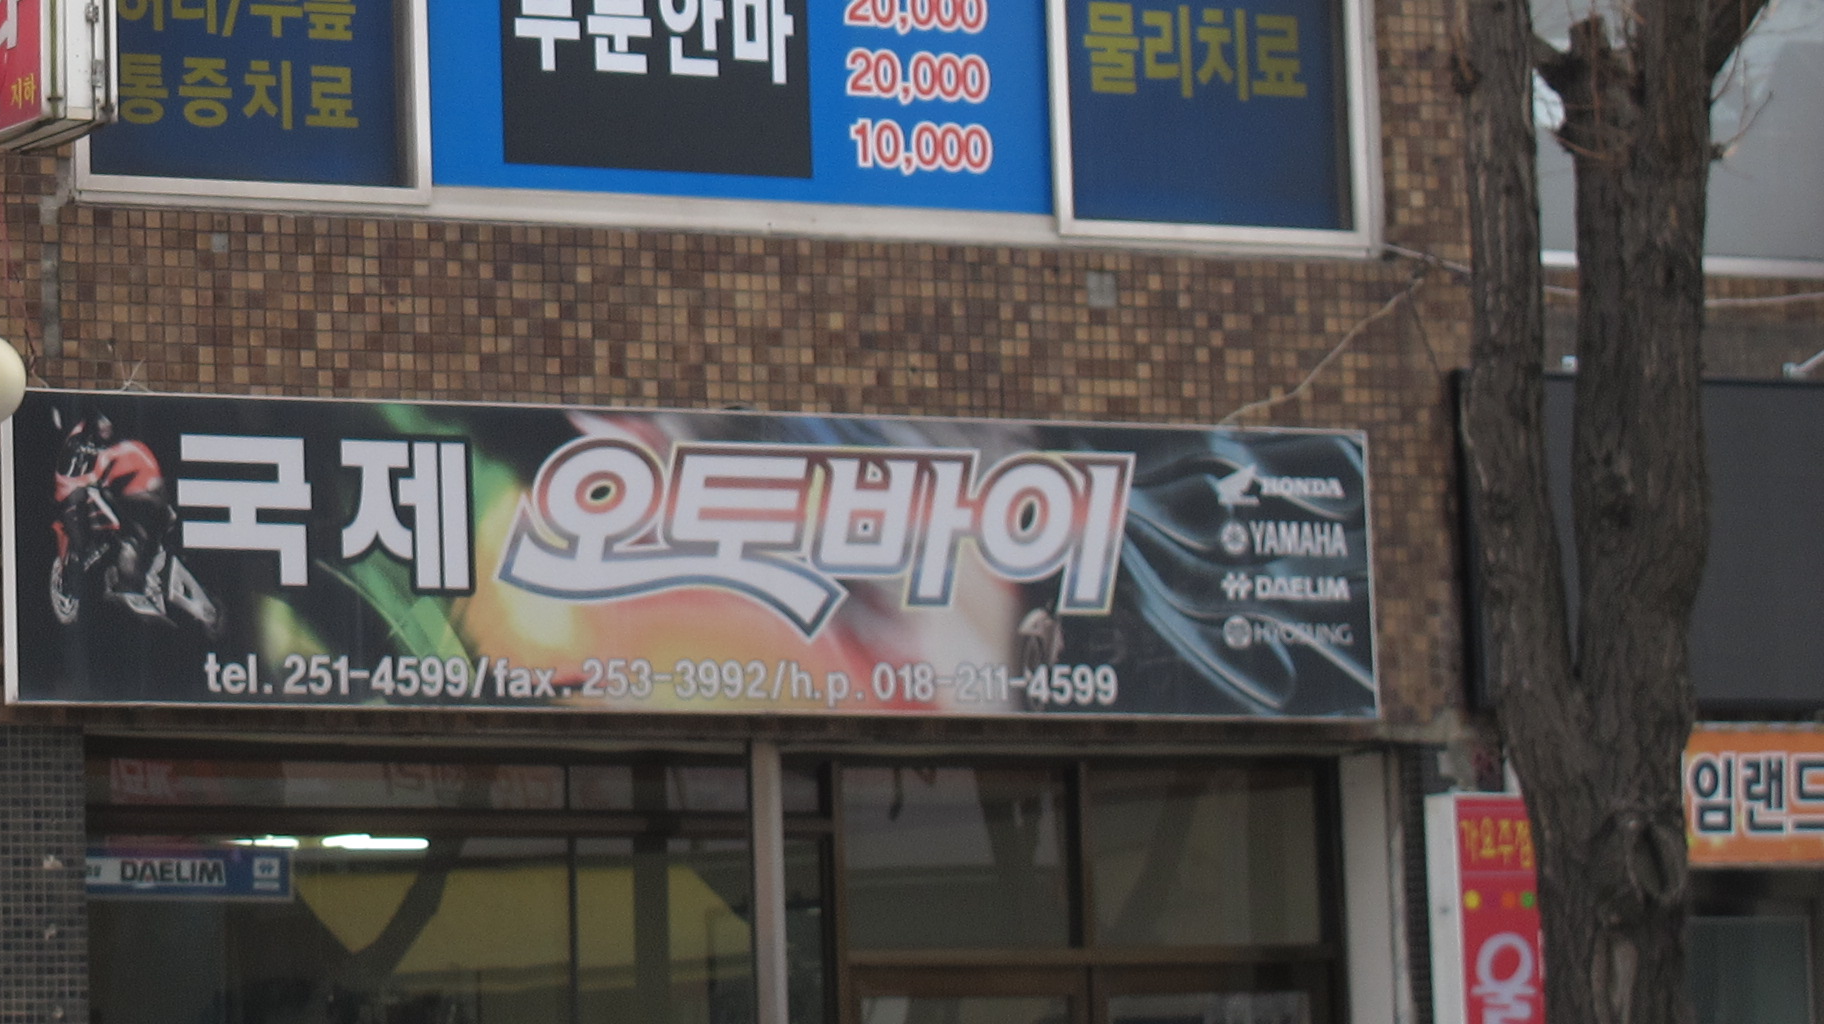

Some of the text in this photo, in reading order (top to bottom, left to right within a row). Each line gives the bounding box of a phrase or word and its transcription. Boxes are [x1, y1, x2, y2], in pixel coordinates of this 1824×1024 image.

[845, 49, 991, 104] 20,000
[1084, 1, 1307, 101] 물리치료
[119, 53, 360, 130] 통증치료
[850, 119, 993, 174] 10,000
[1260, 477, 1345, 498] HONDA
[177, 432, 1137, 644] 국제 오토바이
[1249, 521, 1348, 556] YAMAHA
[1255, 576, 1350, 601] DAELIM
[120, 861, 223, 883] DAELIM
